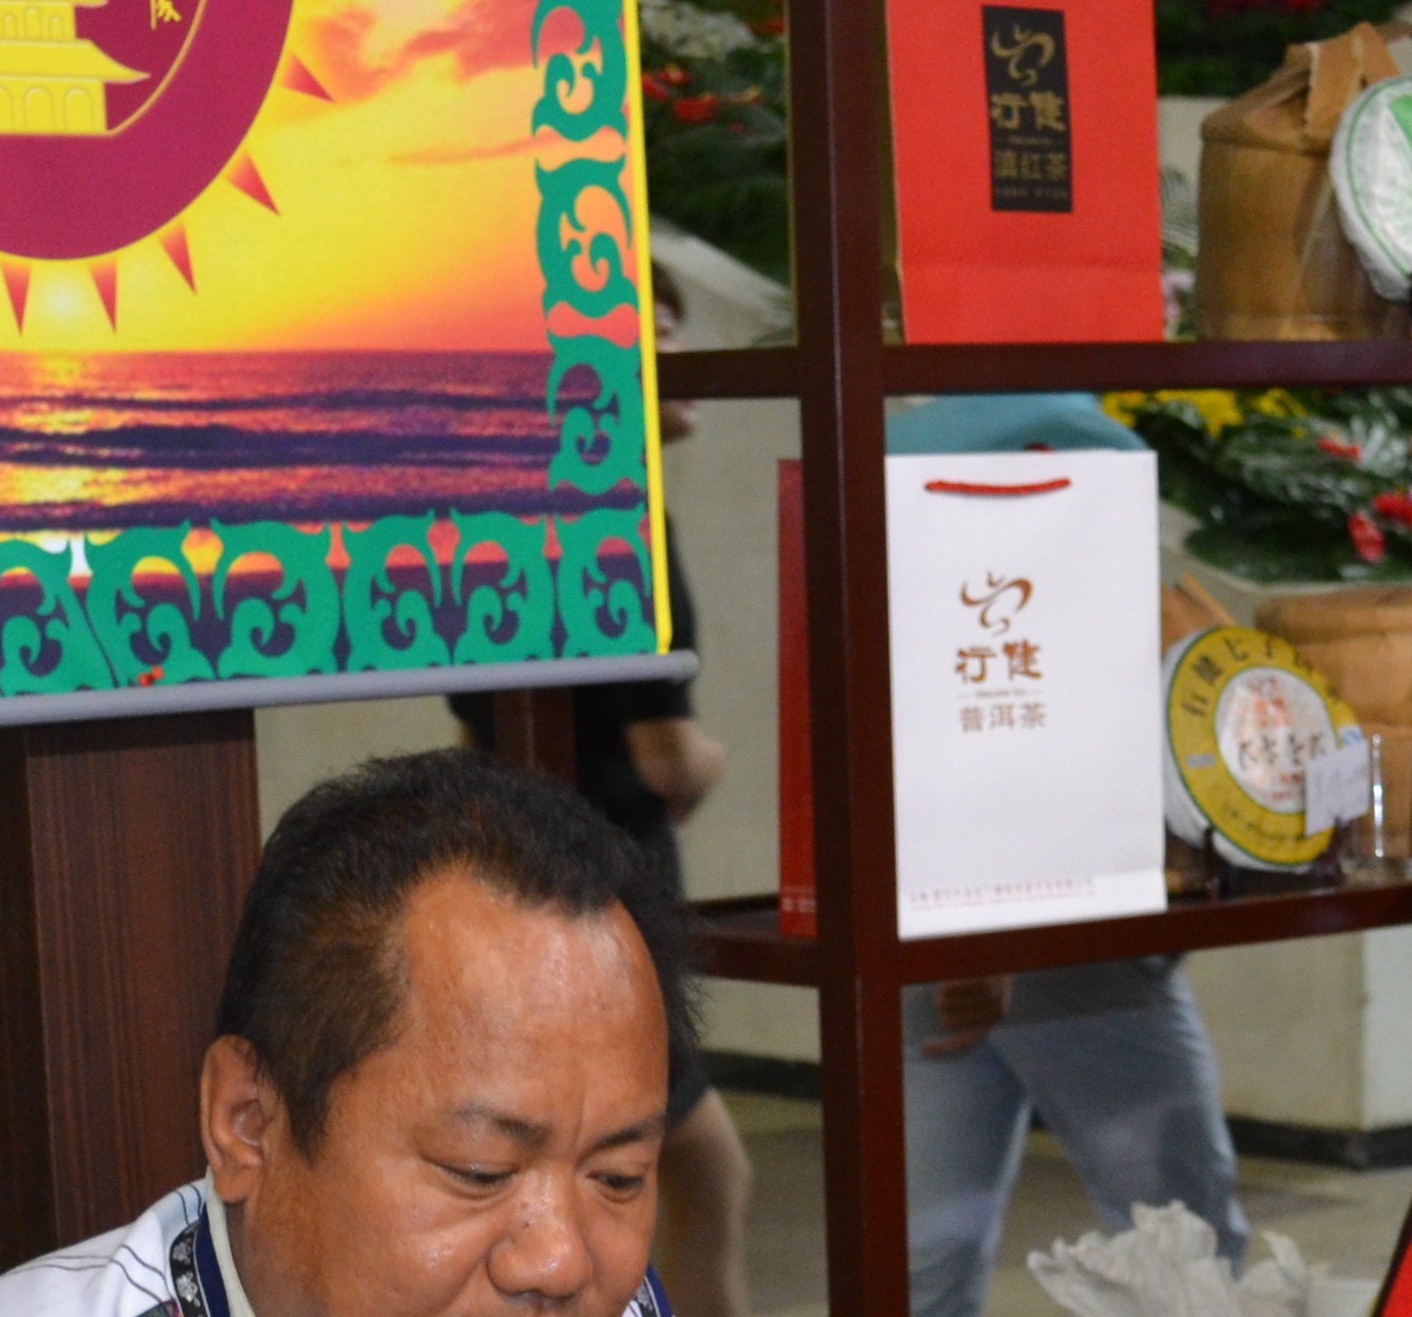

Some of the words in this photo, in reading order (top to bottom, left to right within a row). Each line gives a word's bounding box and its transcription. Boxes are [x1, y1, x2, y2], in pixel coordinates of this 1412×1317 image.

[955, 639, 1043, 684] 行健
[960, 702, 1046, 733] 普洱茶
